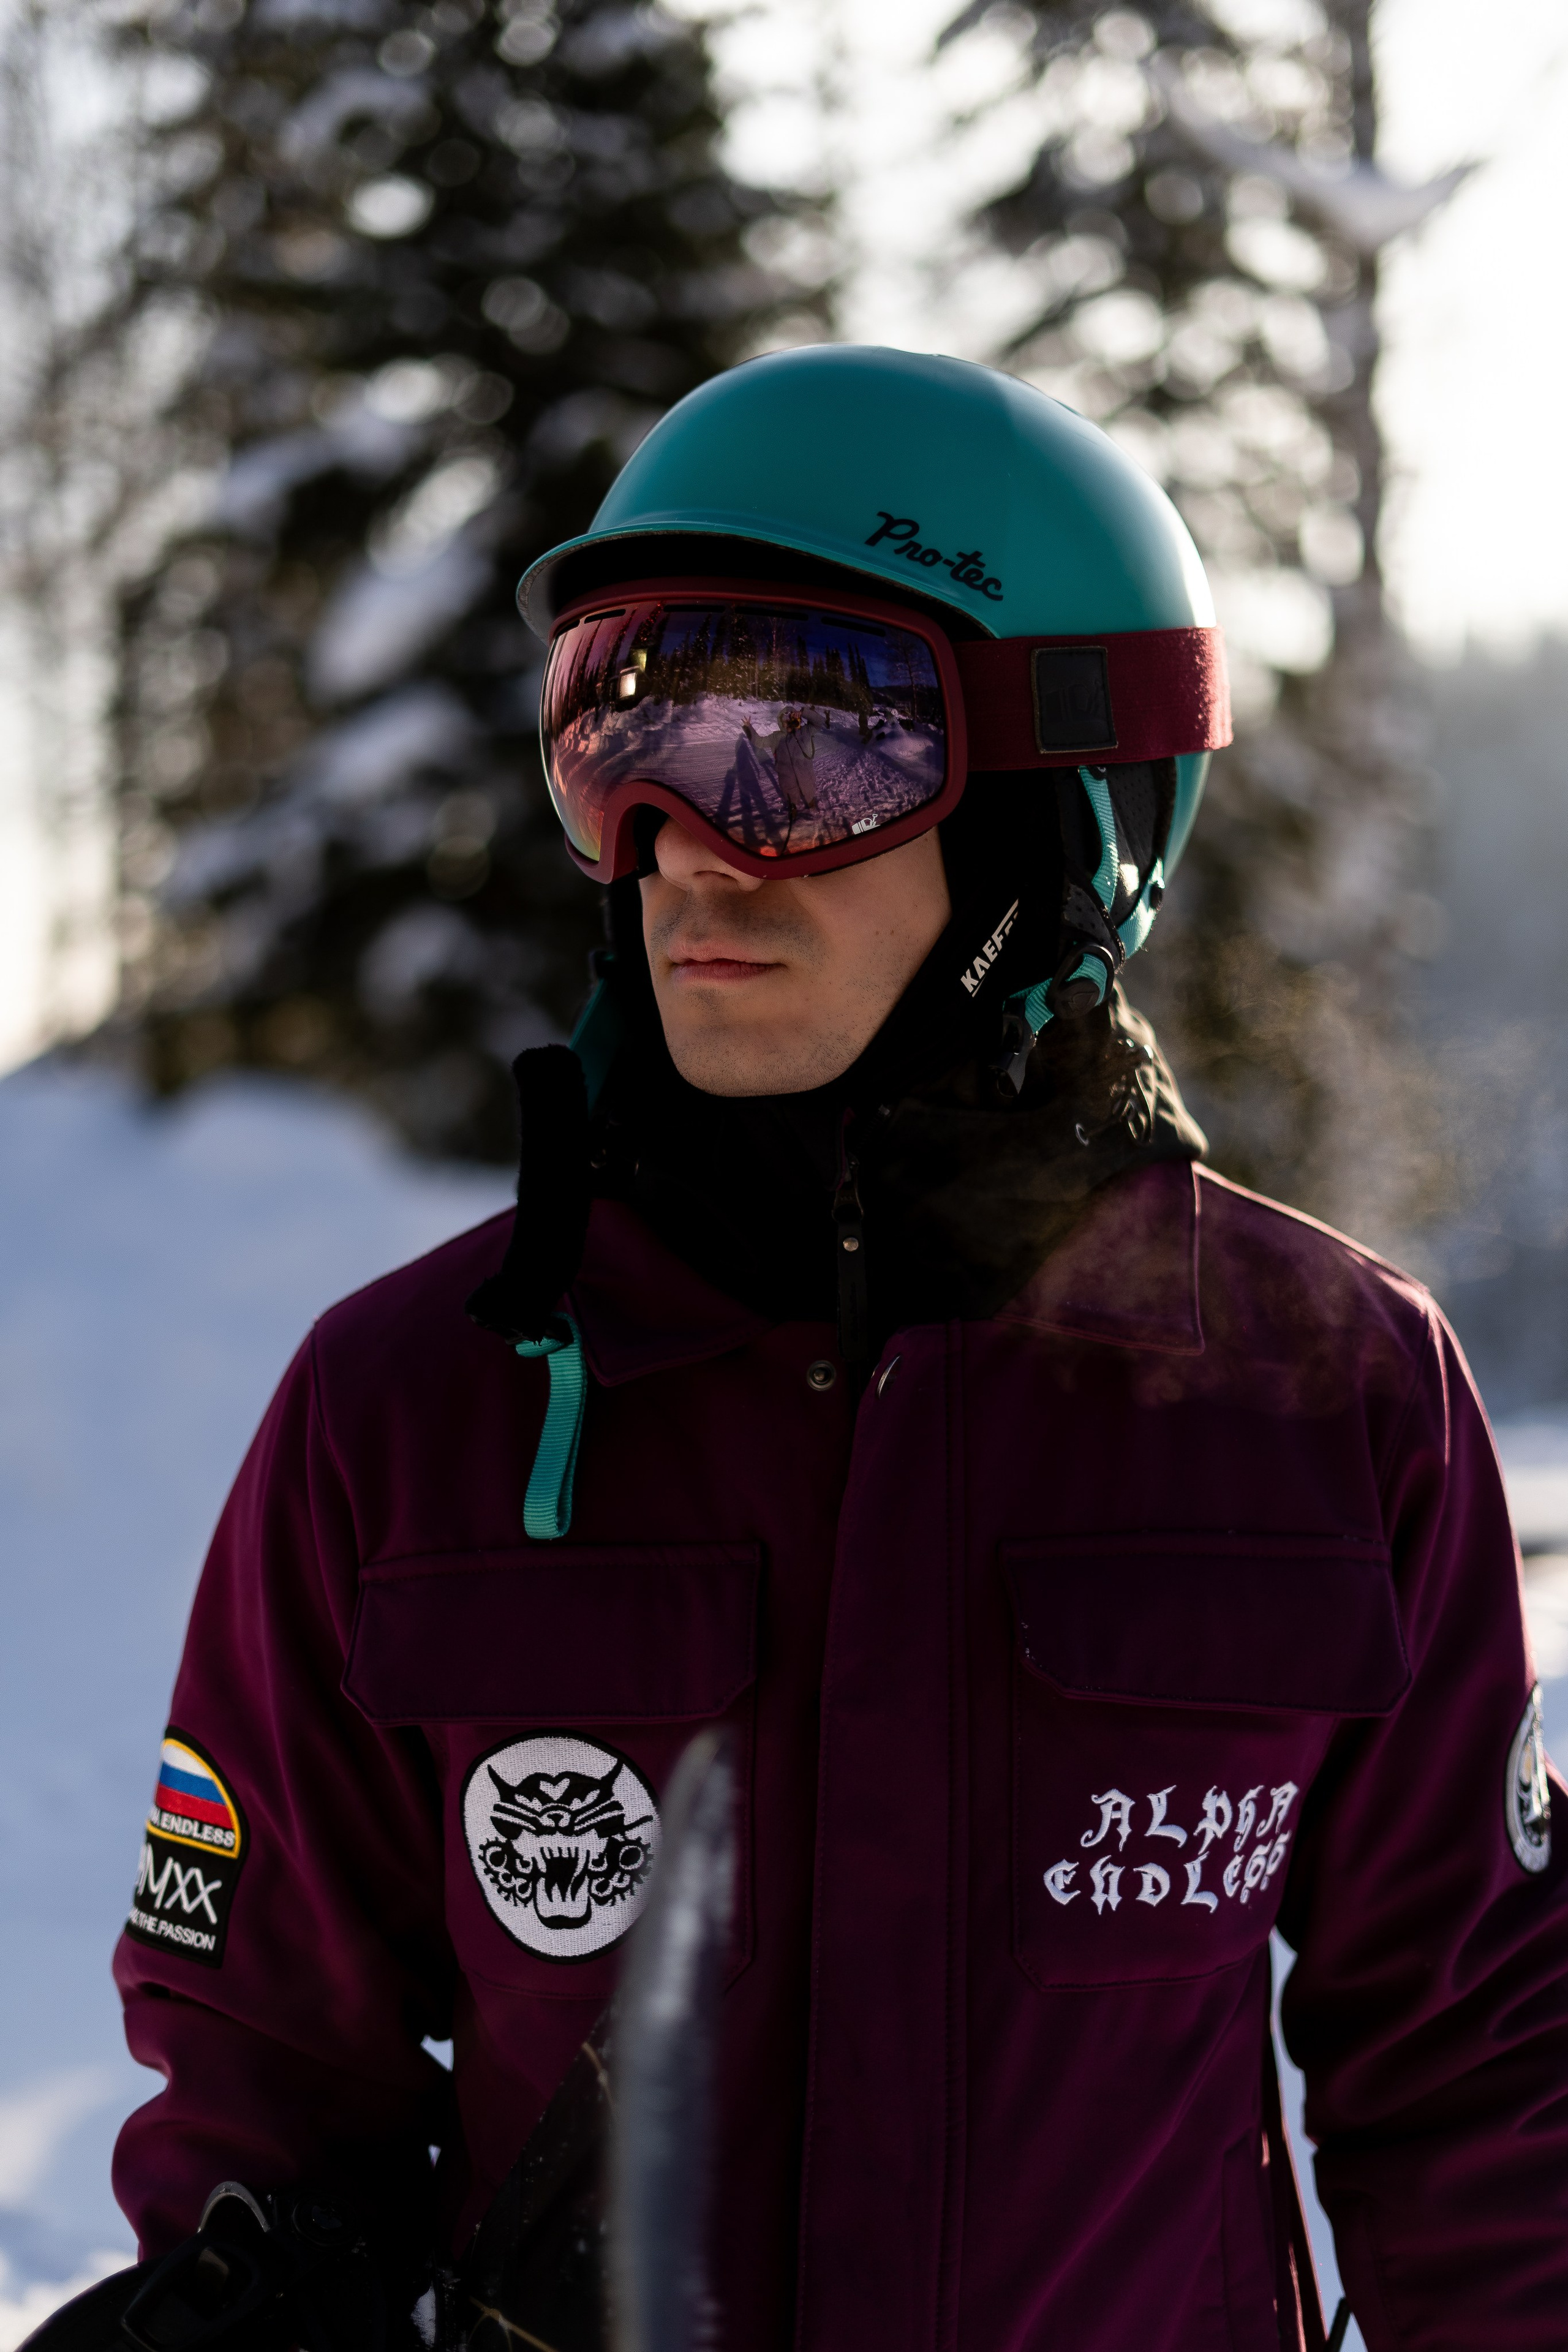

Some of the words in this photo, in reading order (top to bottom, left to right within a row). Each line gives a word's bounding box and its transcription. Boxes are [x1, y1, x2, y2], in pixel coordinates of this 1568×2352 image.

[864, 511, 1004, 601] Pro-tec
[160, 1811, 235, 1848] ENDLESS
[138, 1842, 222, 1924] MXX
[156, 1919, 216, 1951] PASSION
